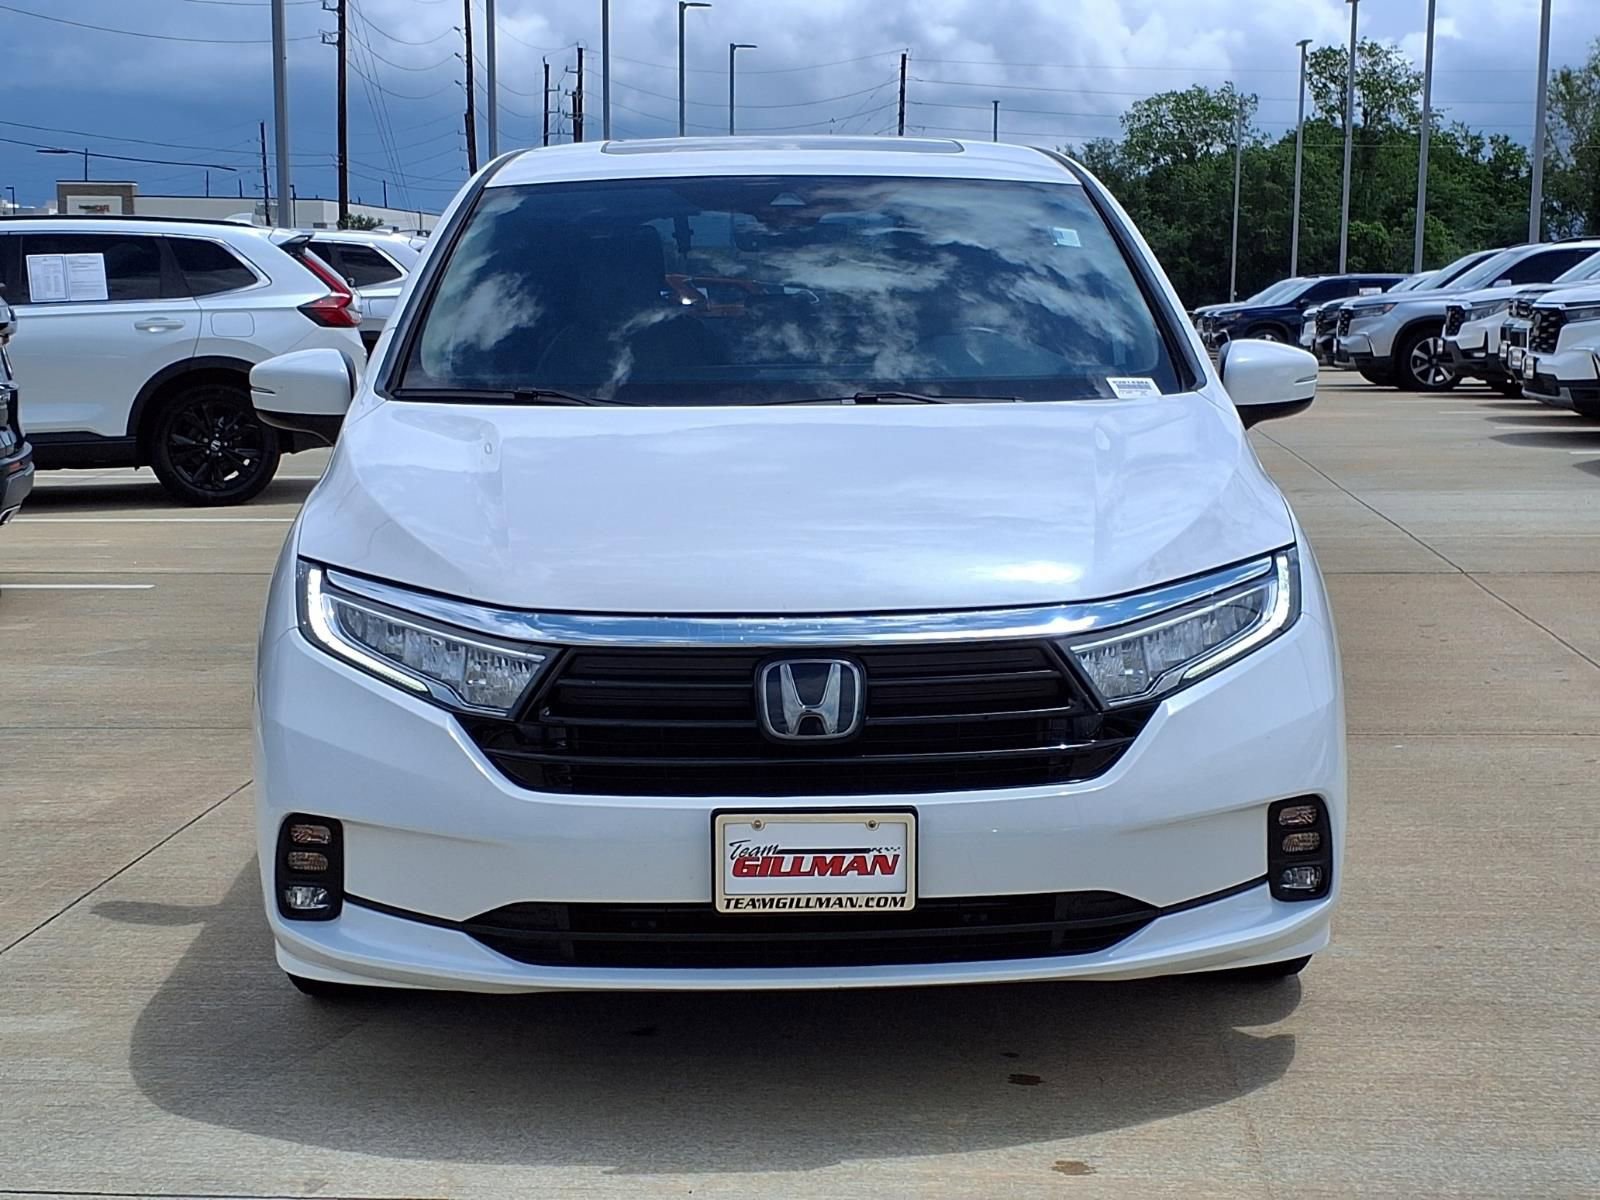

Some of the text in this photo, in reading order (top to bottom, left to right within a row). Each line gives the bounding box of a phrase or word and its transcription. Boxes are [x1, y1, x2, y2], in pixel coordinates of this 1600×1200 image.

[729, 840, 779, 860] Team
[732, 855, 900, 877] GILLMAN
[724, 897, 906, 910] TEAMGILLMAN.COM
